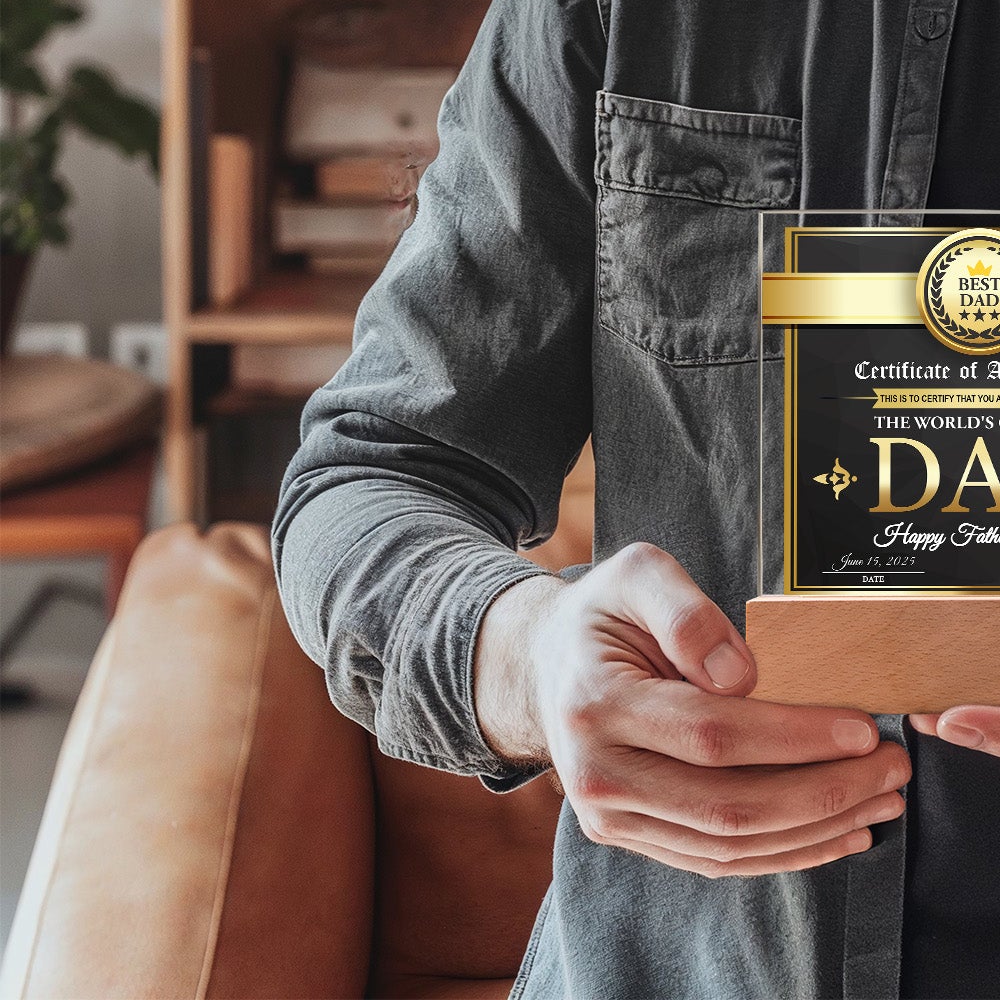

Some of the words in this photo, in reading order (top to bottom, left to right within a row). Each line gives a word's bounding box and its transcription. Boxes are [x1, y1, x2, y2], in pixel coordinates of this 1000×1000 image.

[959, 293, 1000, 307] DAD
[854, 360, 951, 380] Certificate
[959, 361, 979, 380] of
[880, 394, 898, 403] THIS
[899, 394, 907, 403] IS
[909, 394, 920, 403] TO
[921, 394, 954, 403] CERTIFY
[956, 394, 977, 403] THAT
[978, 394, 995, 403] YOU
[873, 415, 911, 429] THE
[914, 415, 995, 430] WORLD'S
[873, 521, 947, 552] Happy
[831, 552, 864, 572] June
[866, 556, 882, 568] 15,
[885, 556, 916, 566] 2025
[862, 575, 885, 583] DATE
